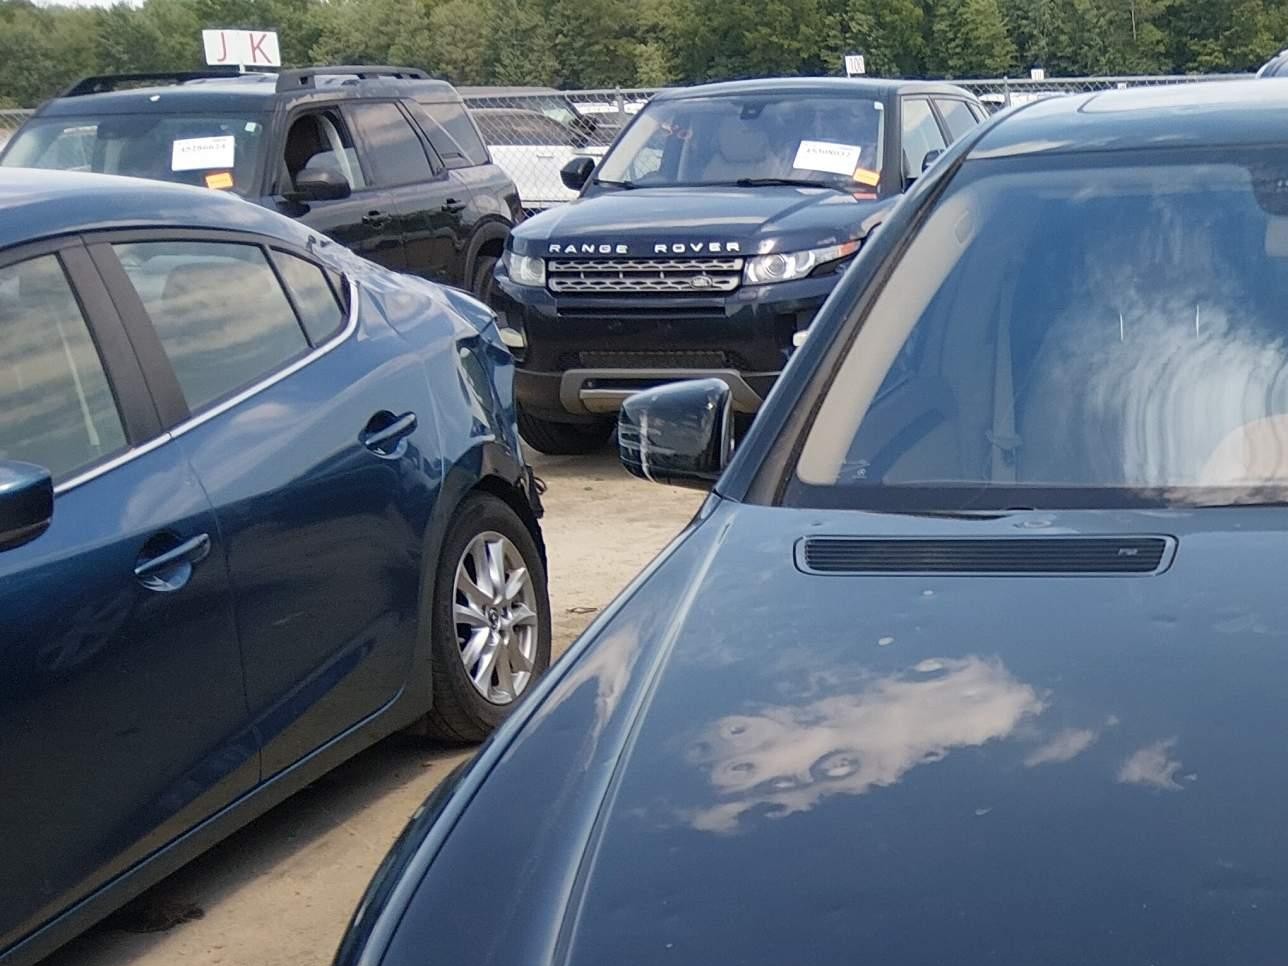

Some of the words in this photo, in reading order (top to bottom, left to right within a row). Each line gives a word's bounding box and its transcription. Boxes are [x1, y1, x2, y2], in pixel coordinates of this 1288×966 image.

[217, 31, 227, 62] J
[249, 32, 272, 64] K
[550, 244, 628, 254] RANGE
[654, 242, 740, 254] ROVER
